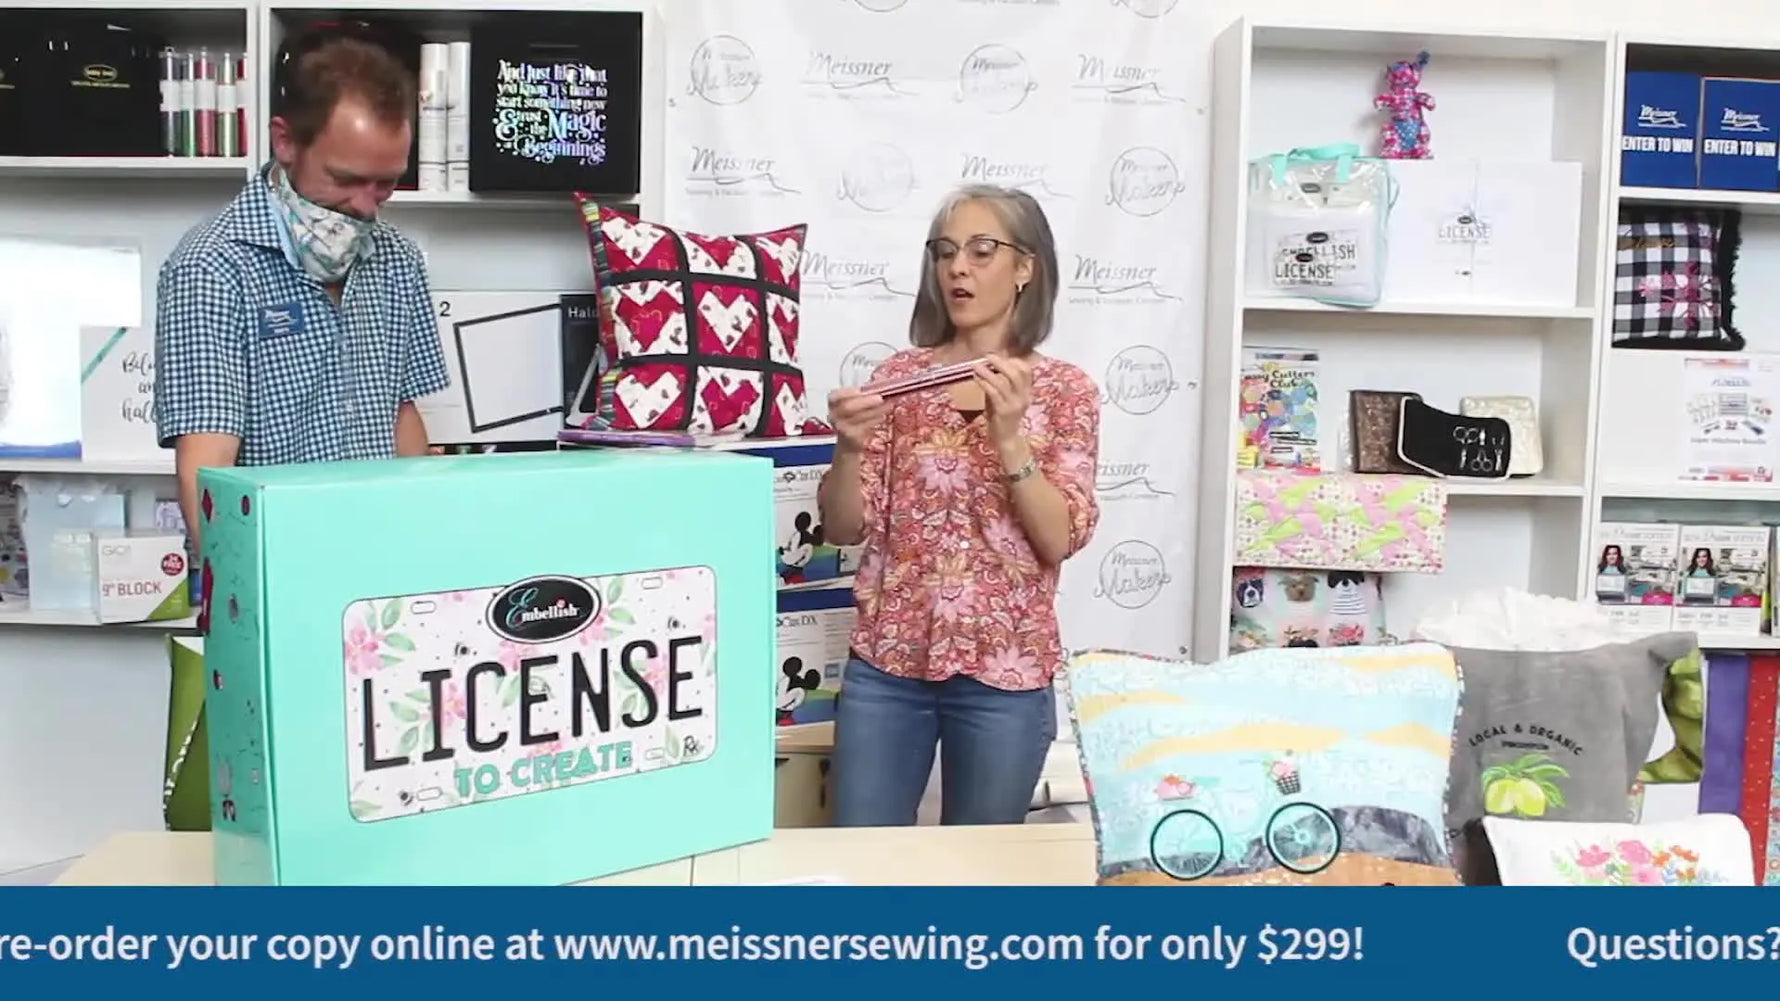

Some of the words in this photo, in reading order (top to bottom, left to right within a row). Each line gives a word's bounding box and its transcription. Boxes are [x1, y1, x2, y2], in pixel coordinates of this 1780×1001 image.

[806, 50, 893, 79] Meissner
[541, 108, 607, 142] Magic
[1622, 135, 1656, 151] ENTER
[1658, 137, 1671, 152] TO
[1672, 138, 1694, 153] WIN
[1704, 138, 1738, 154] ENTER
[1740, 140, 1753, 155] TO
[1755, 141, 1776, 157] WIN
[1438, 225, 1491, 239] LICENSE
[801, 248, 890, 280] Meissner
[1075, 254, 1157, 284] Meissner
[1275, 263, 1335, 279] LICENSE
[439, 301, 451, 317] 2
[1269, 379, 1299, 388] Club
[118, 581, 162, 596] BLOCK
[505, 587, 580, 631] Embellish
[363, 636, 704, 772] LICENSE
[1468, 724, 1508, 748] LOCAL
[1514, 723, 1524, 734] &
[1529, 725, 1585, 756] ORGANIC
[454, 765, 500, 798] TO
[510, 740, 633, 789] CREATE
